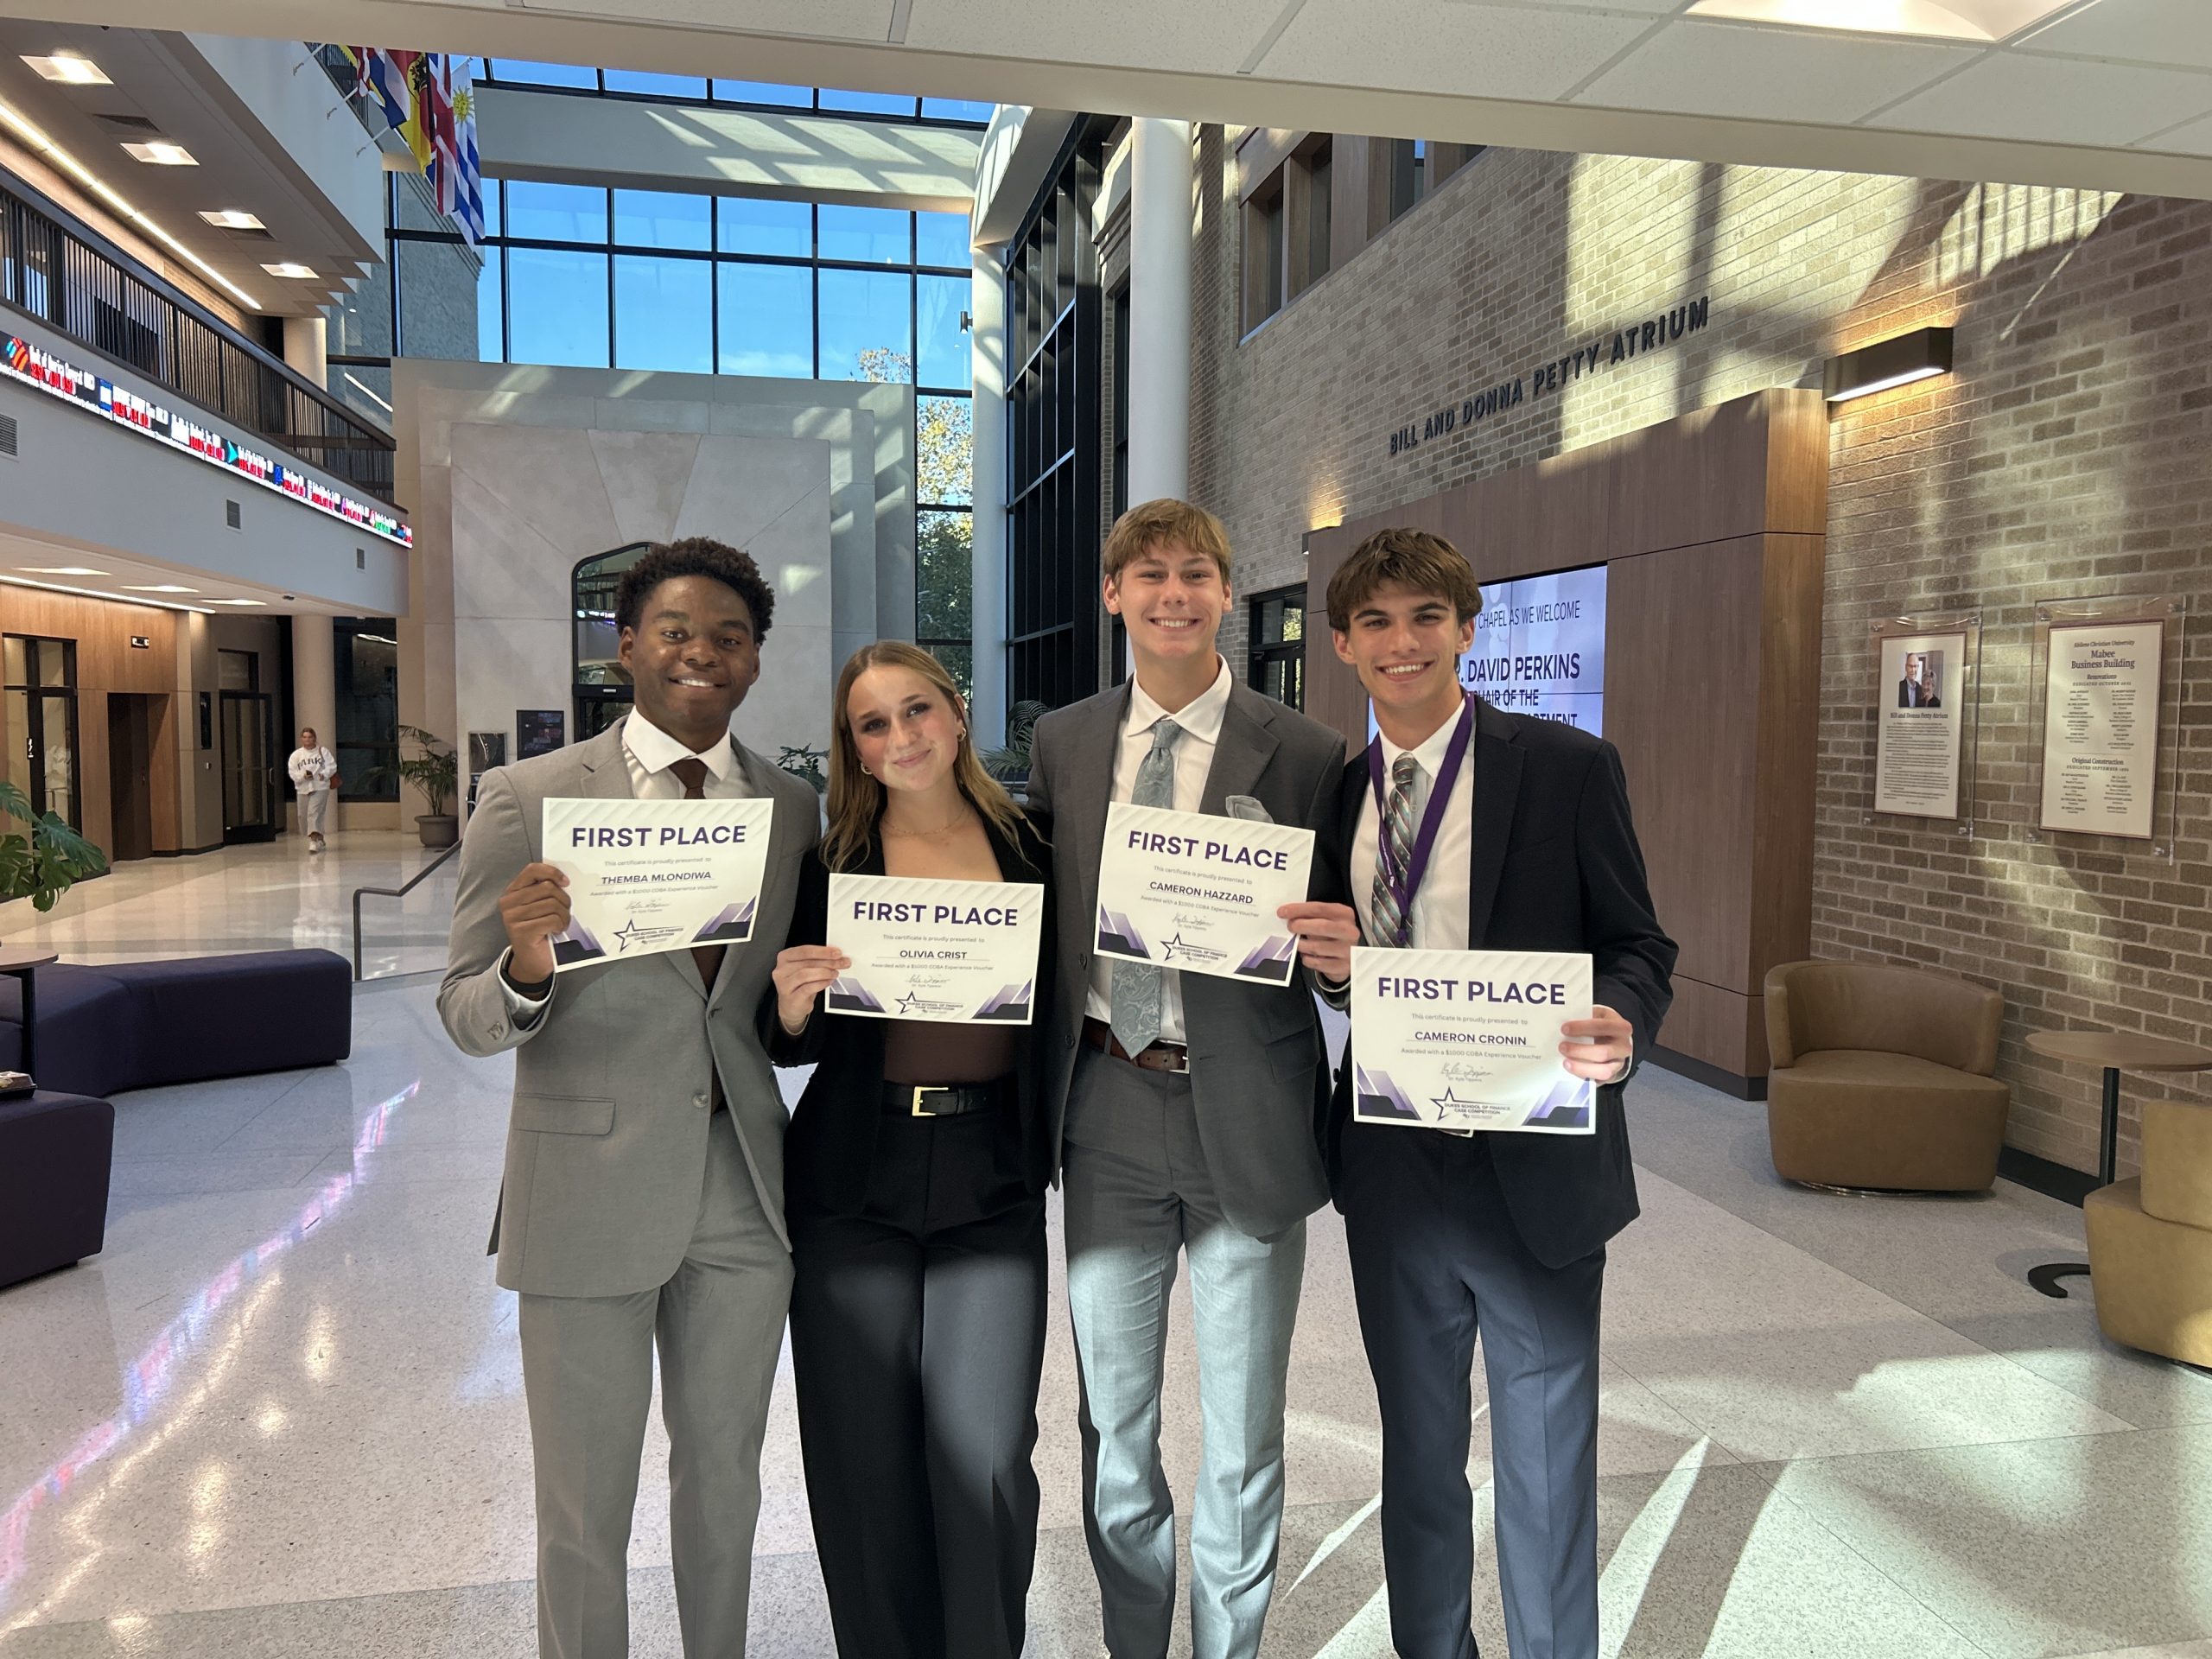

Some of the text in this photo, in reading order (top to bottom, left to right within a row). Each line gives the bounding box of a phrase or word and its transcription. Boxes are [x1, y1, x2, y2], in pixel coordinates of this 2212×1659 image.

[1390, 296, 1709, 454] BILL AND DONNA PETTY ATRIUM
[1478, 601, 1580, 629] CHAPEL AS WE WELCOME
[2072, 658, 2135, 669] Business Building
[2091, 650, 2115, 658] Mabee
[1468, 658, 1510, 682] DAVID
[1515, 653, 1580, 681] PERKINS
[1503, 690, 1517, 706] OF
[1519, 690, 1539, 706] THE
[572, 825, 747, 848] FIRST PLACE
[1128, 830, 1287, 871] FIRST PLACE
[601, 872, 711, 885] THEMBA MLONDIWA
[1165, 868, 1191, 876] certificate
[1197, 872, 1217, 880] proudly
[1217, 874, 1244, 884] presented
[1150, 881, 1253, 904] CAMERON HAZZARD
[854, 901, 1018, 926] FIRST PLACE
[1378, 977, 1566, 1005] FIRST PLACE
[1414, 1032, 1527, 1046] CAMERON CRONIN
